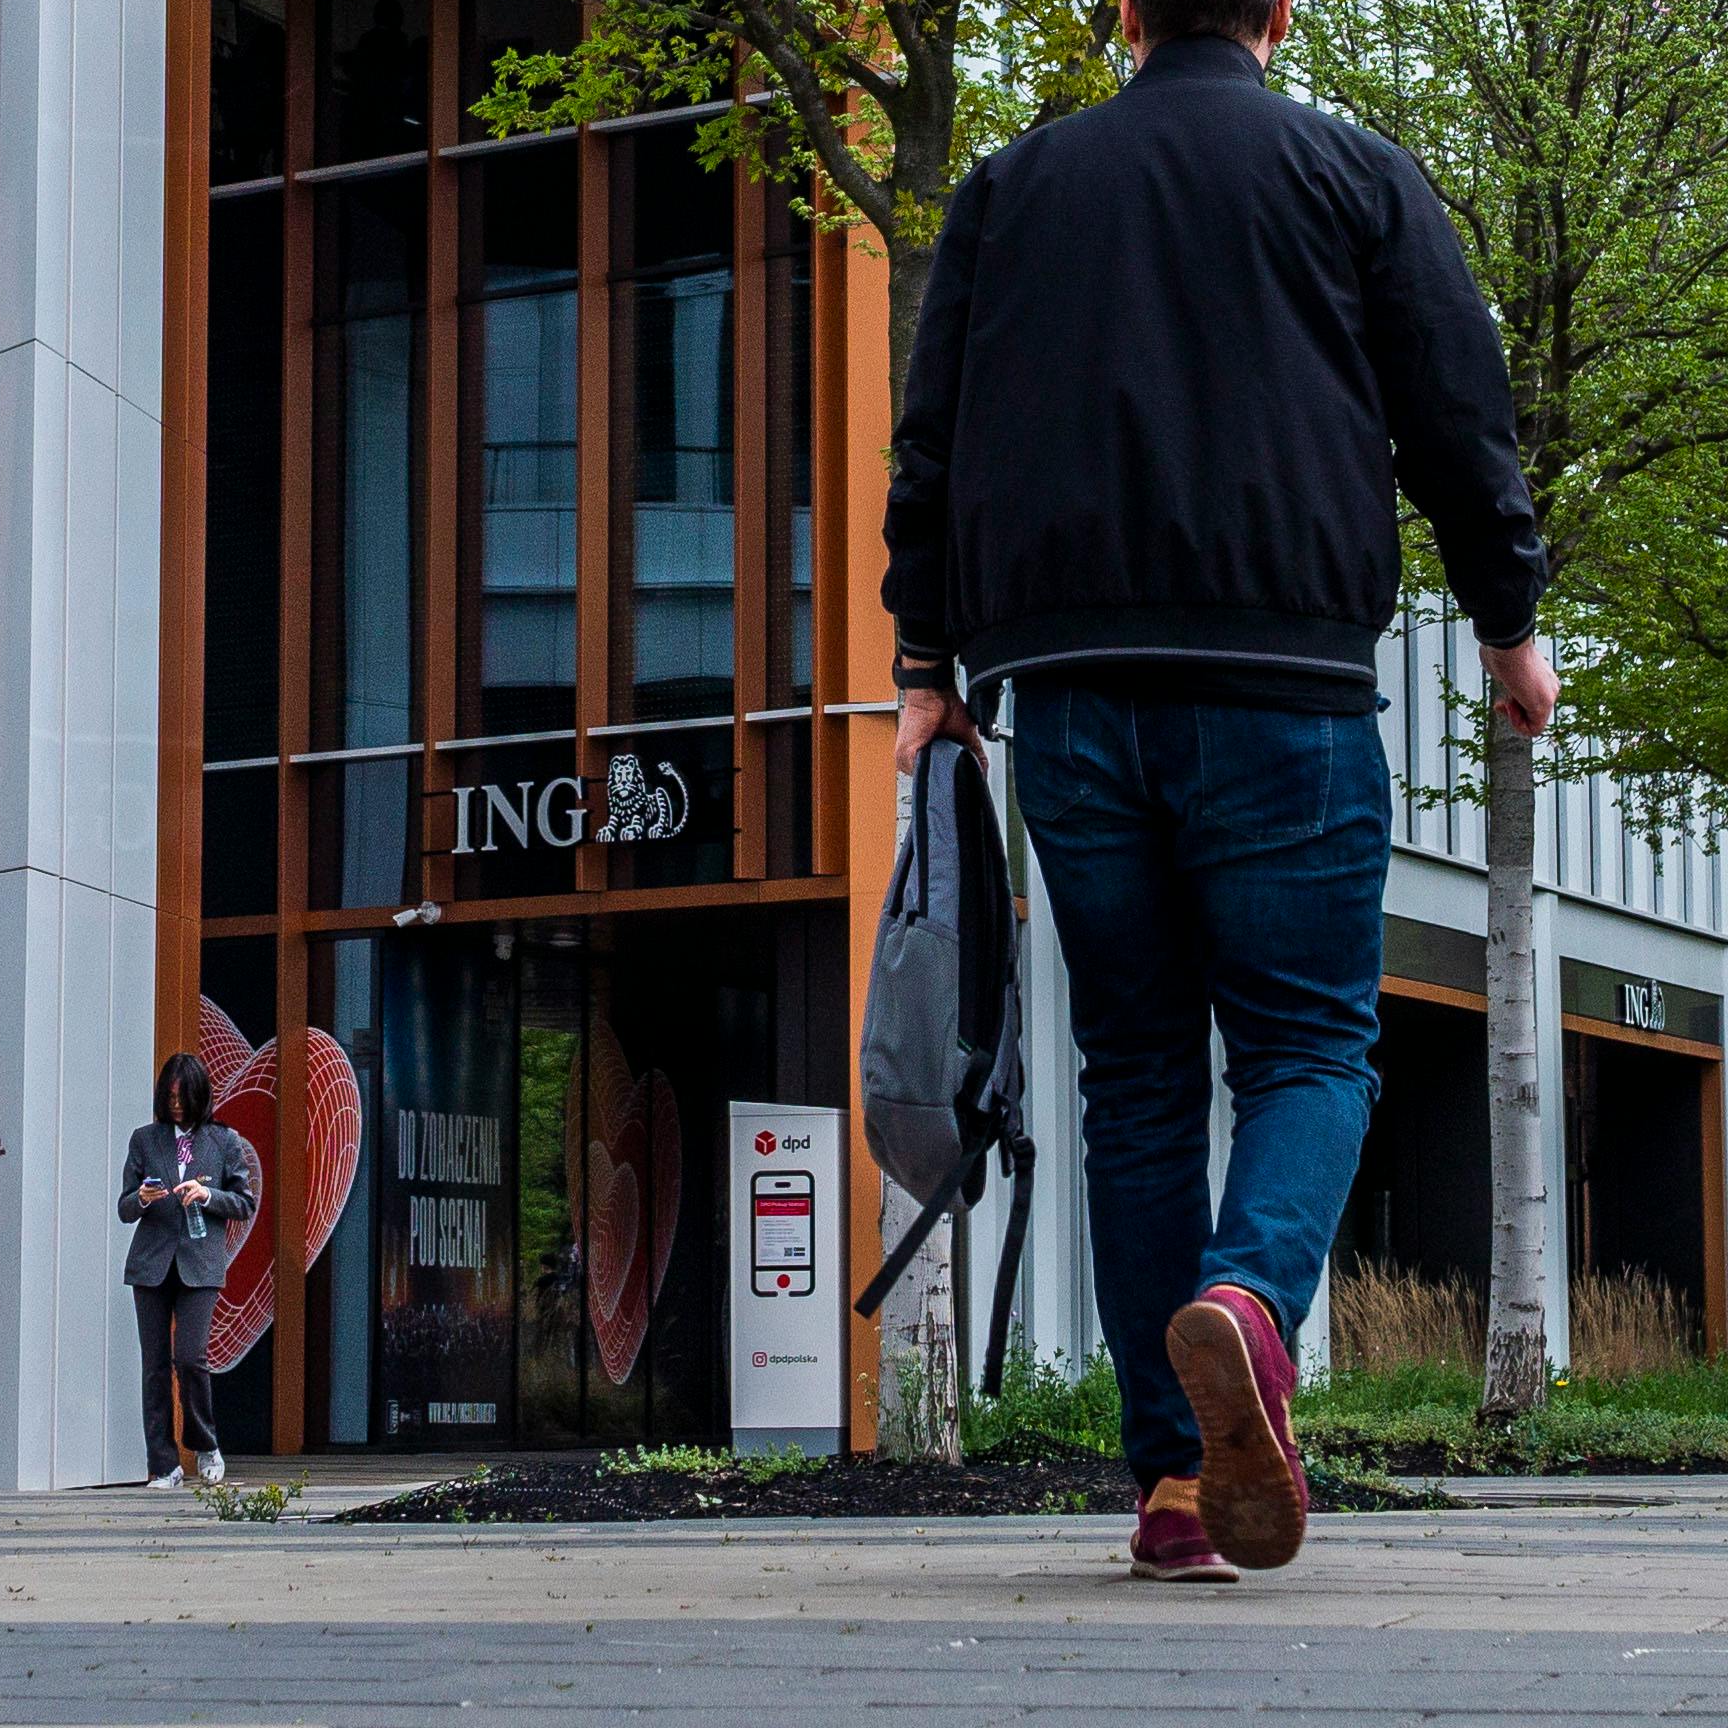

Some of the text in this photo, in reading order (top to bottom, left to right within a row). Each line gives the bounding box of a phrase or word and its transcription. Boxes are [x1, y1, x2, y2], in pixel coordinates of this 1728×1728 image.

[452, 776, 588, 854] ING
[1625, 983, 1649, 1029] ING
[398, 1109, 501, 1185] DO ZOBACZENIA
[781, 1134, 811, 1153] dpd
[410, 1195, 436, 1267] POD
[769, 1354, 818, 1365] dpdpolska
